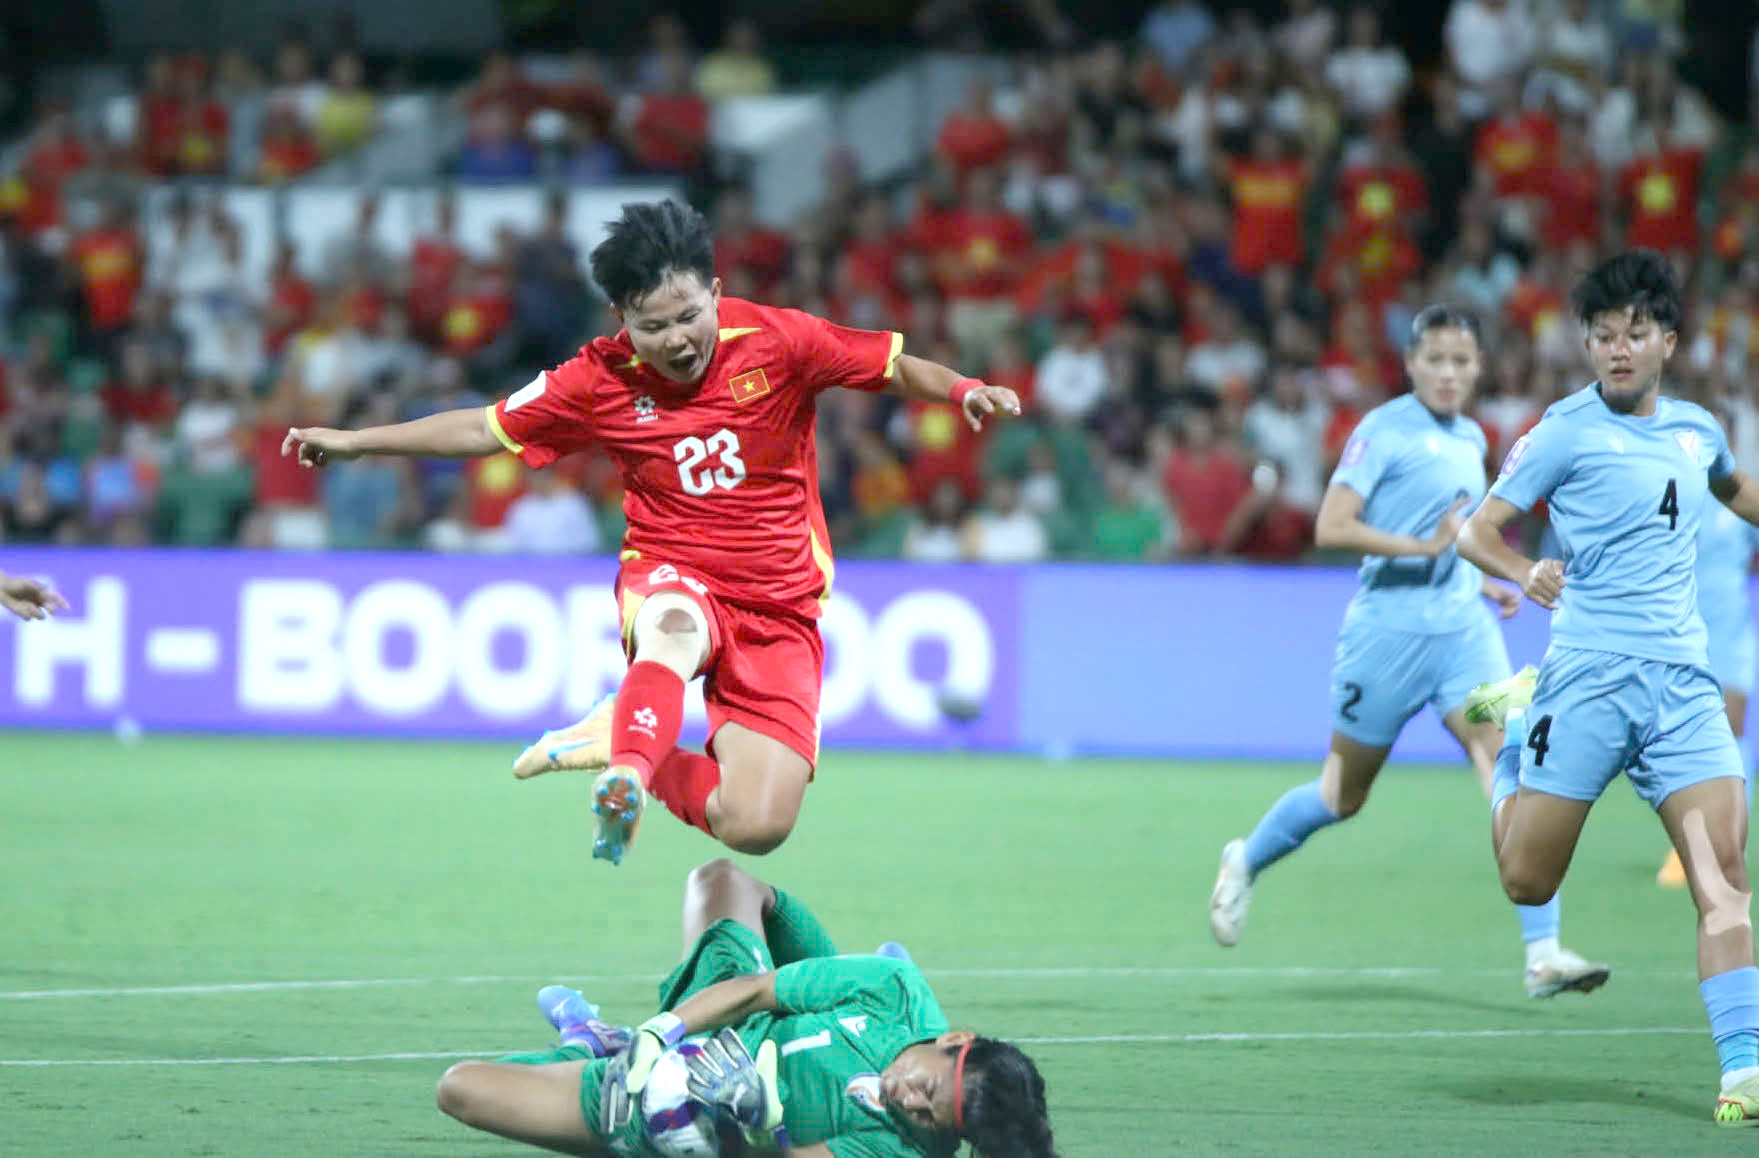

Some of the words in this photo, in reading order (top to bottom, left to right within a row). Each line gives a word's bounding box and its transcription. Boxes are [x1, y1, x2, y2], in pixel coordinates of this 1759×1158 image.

[673, 428, 747, 495] 23
[1659, 478, 1679, 530] 4
[1340, 681, 1362, 722] 2
[1528, 714, 1553, 766] 4
